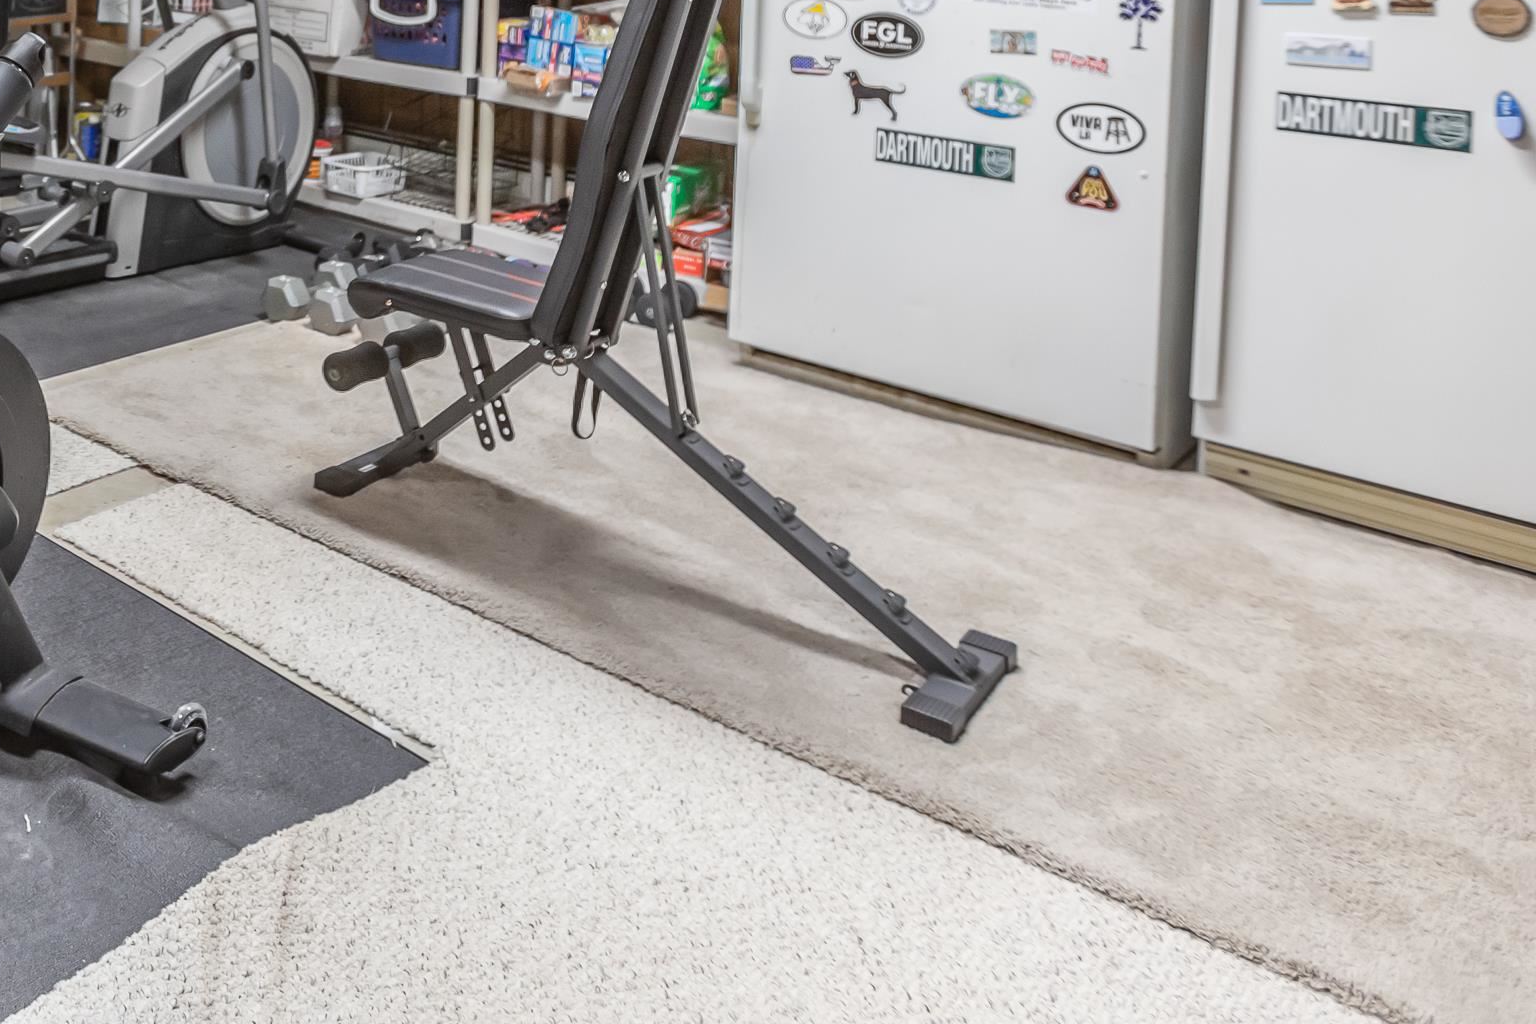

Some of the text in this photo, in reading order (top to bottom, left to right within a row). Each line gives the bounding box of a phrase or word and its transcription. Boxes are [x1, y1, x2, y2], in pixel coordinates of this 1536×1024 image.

[862, 20, 913, 45] FGL
[974, 80, 1019, 105] FLY
[1071, 114, 1102, 131] VIVA
[1277, 93, 1414, 144] DARTMOUTH
[877, 130, 975, 174] DARTMOUTH
